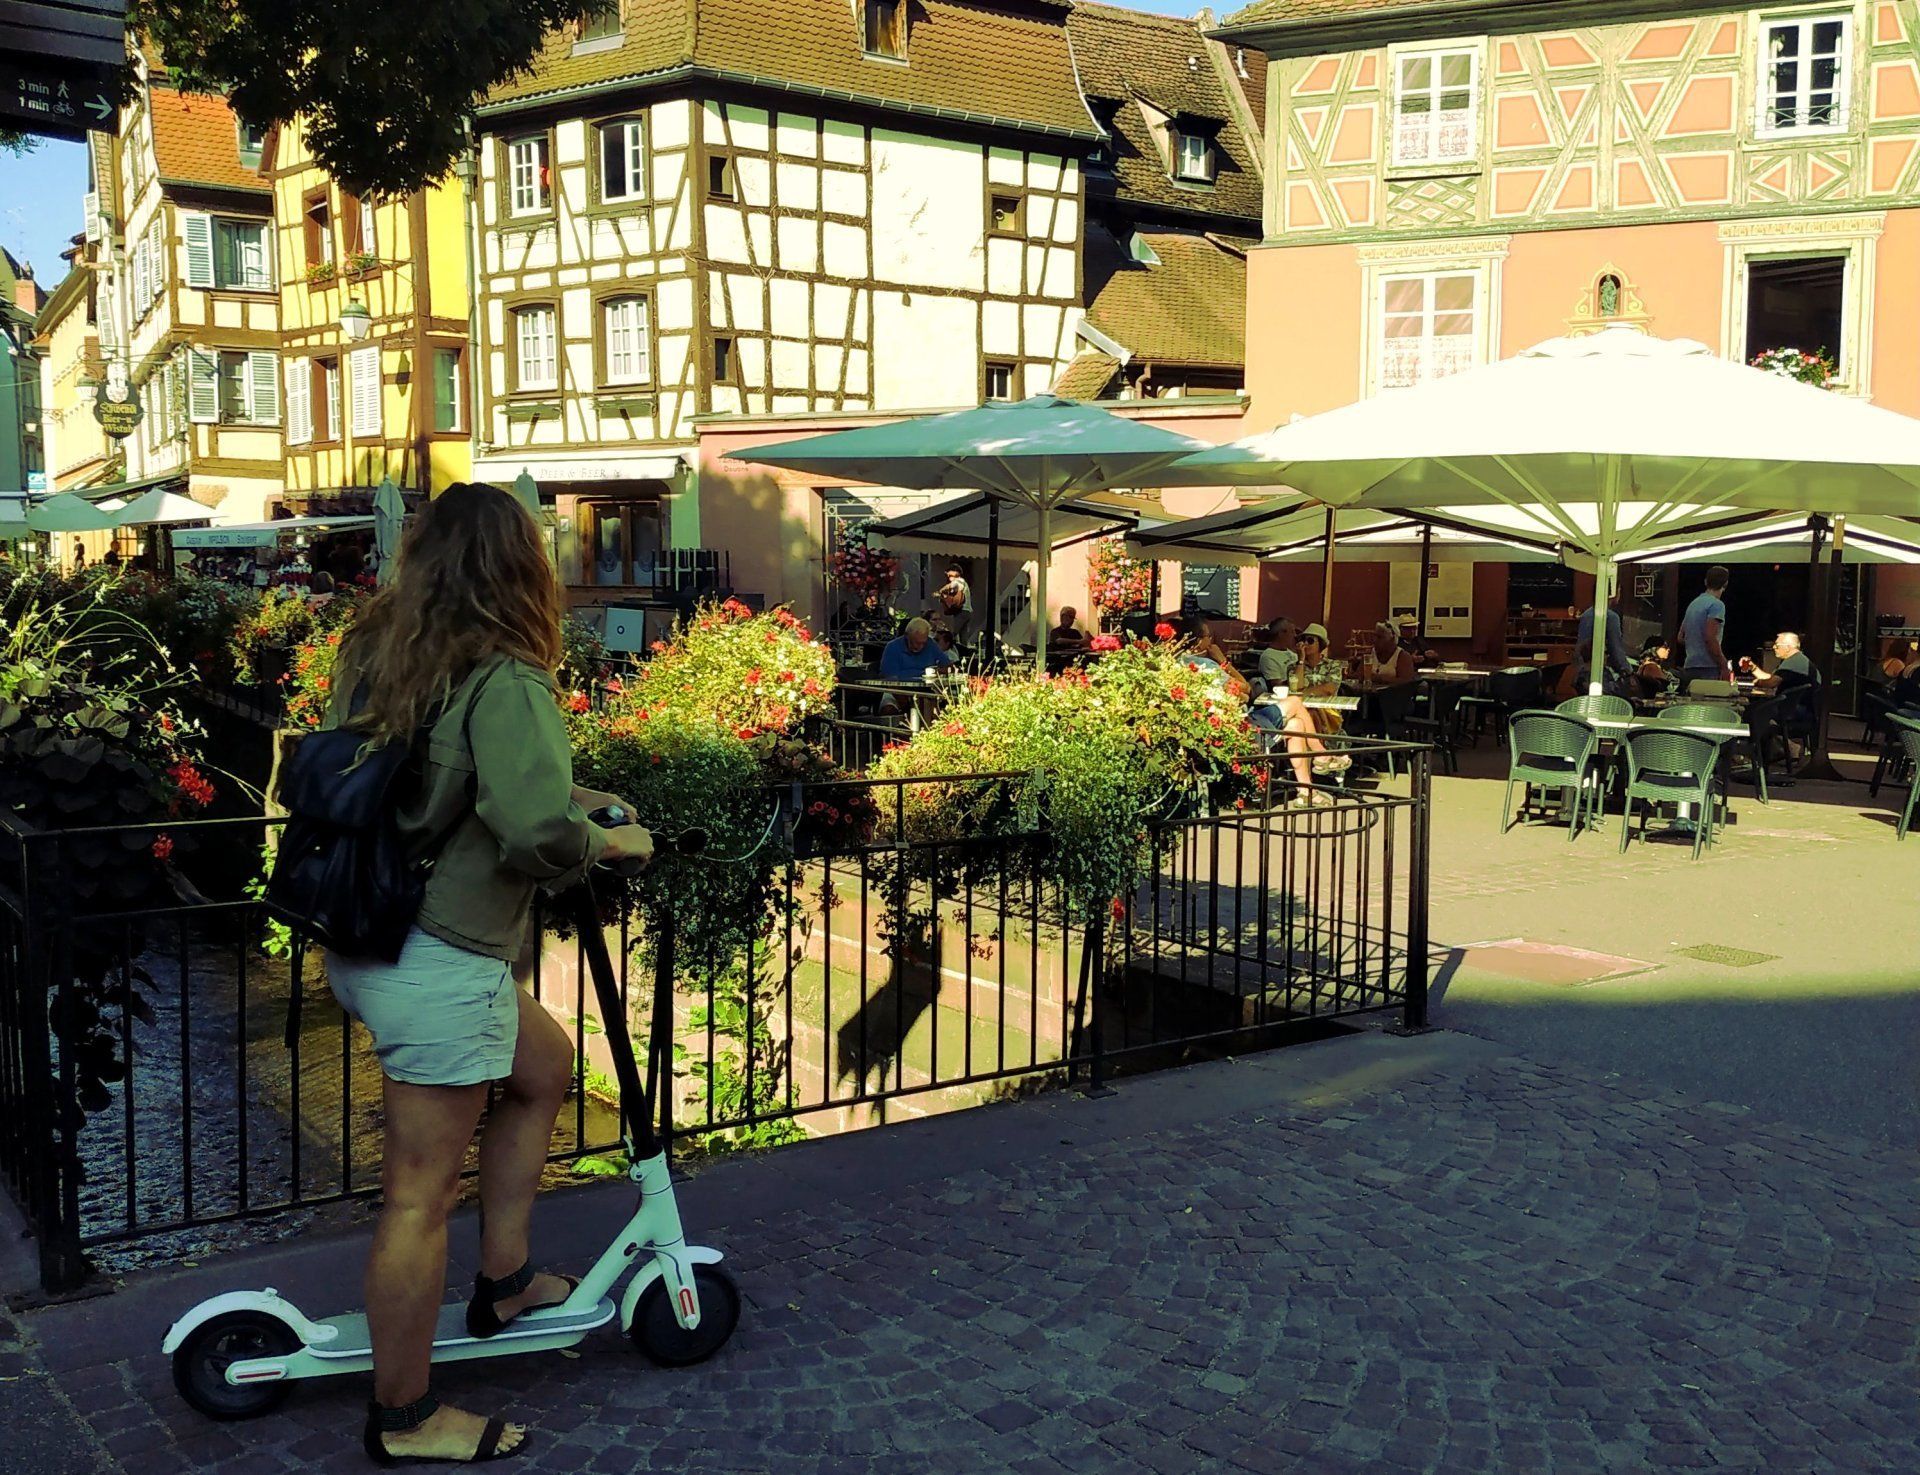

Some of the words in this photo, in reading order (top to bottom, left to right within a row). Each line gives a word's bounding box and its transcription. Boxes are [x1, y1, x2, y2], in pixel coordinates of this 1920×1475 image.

[19, 79, 26, 90] 3
[28, 83, 50, 95] min
[19, 96, 25, 107] 1
[28, 99, 50, 112] min
